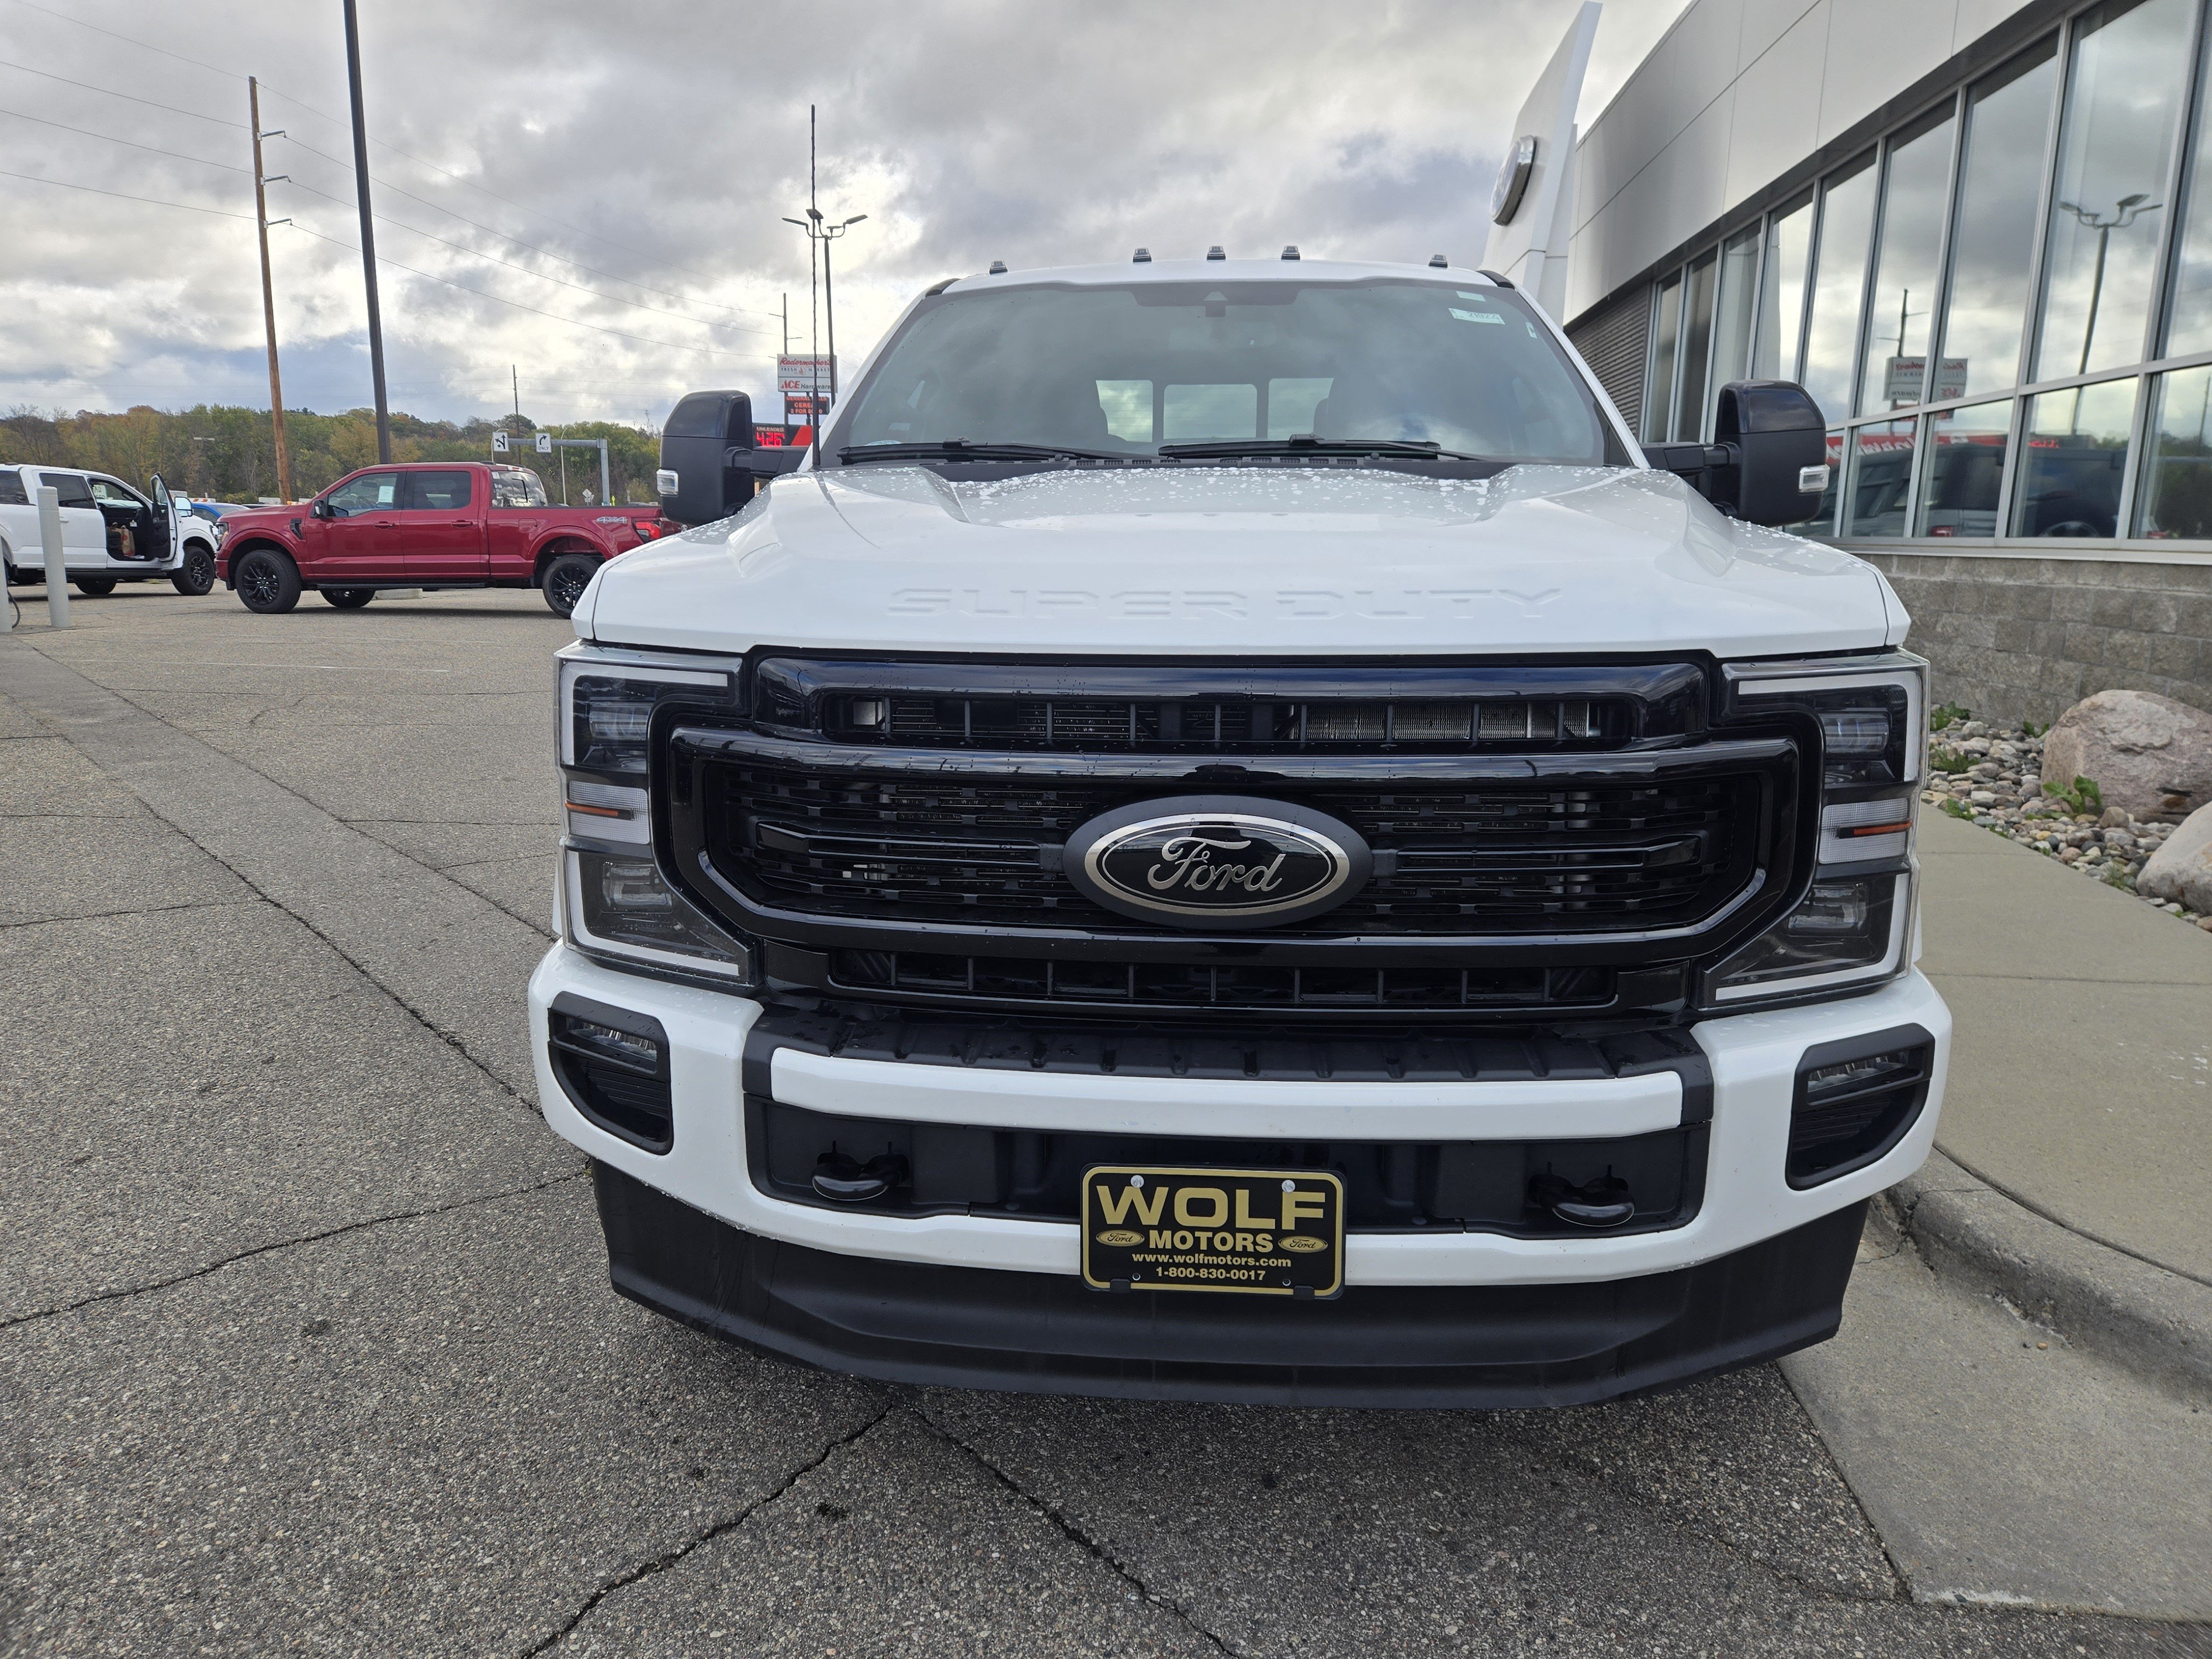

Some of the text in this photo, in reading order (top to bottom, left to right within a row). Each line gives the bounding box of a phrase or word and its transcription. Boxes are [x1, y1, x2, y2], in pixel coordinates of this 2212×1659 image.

[780, 357, 830, 366] Radermaher'
[781, 379, 800, 389] ACE
[887, 588, 1561, 620] SUPER DUTY
[1147, 837, 1287, 891] Ford
[1096, 1185, 1326, 1230] WOLF
[1149, 1230, 1273, 1253] MOTORS
[1132, 1252, 1291, 1267] www.wolfmotors.com
[1156, 1267, 1266, 1280] 1-800-830-0017
